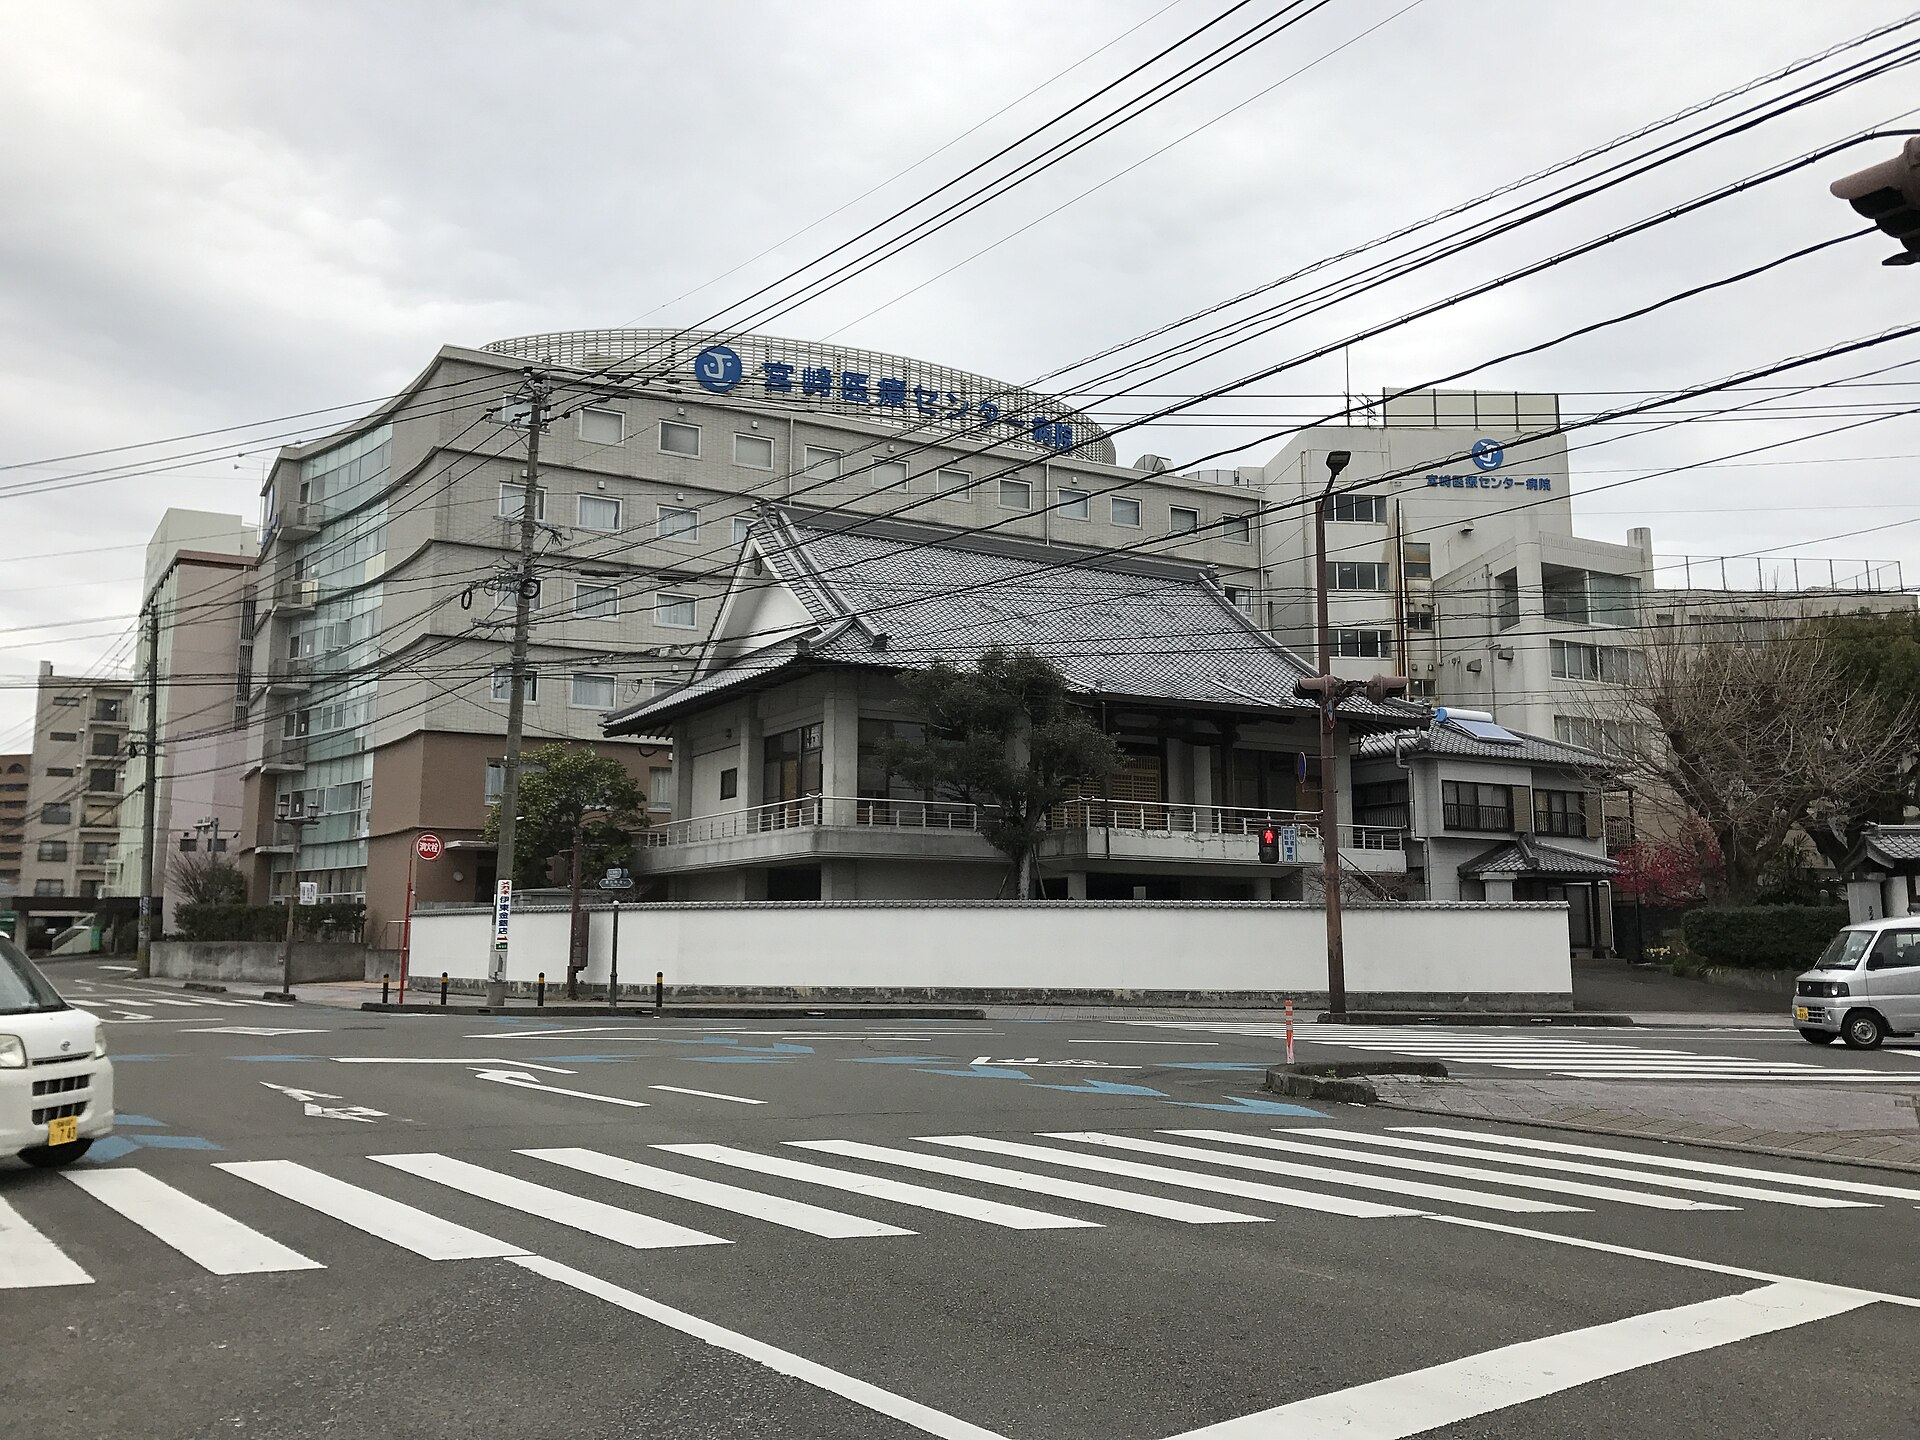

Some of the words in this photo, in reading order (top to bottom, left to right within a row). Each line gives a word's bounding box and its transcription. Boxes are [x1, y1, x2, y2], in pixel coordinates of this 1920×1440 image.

[762, 361, 1074, 456] 宮崎医療センター病院
[1426, 474, 1552, 492] 宮崎医療センター病院
[419, 841, 439, 853] 消火栓
